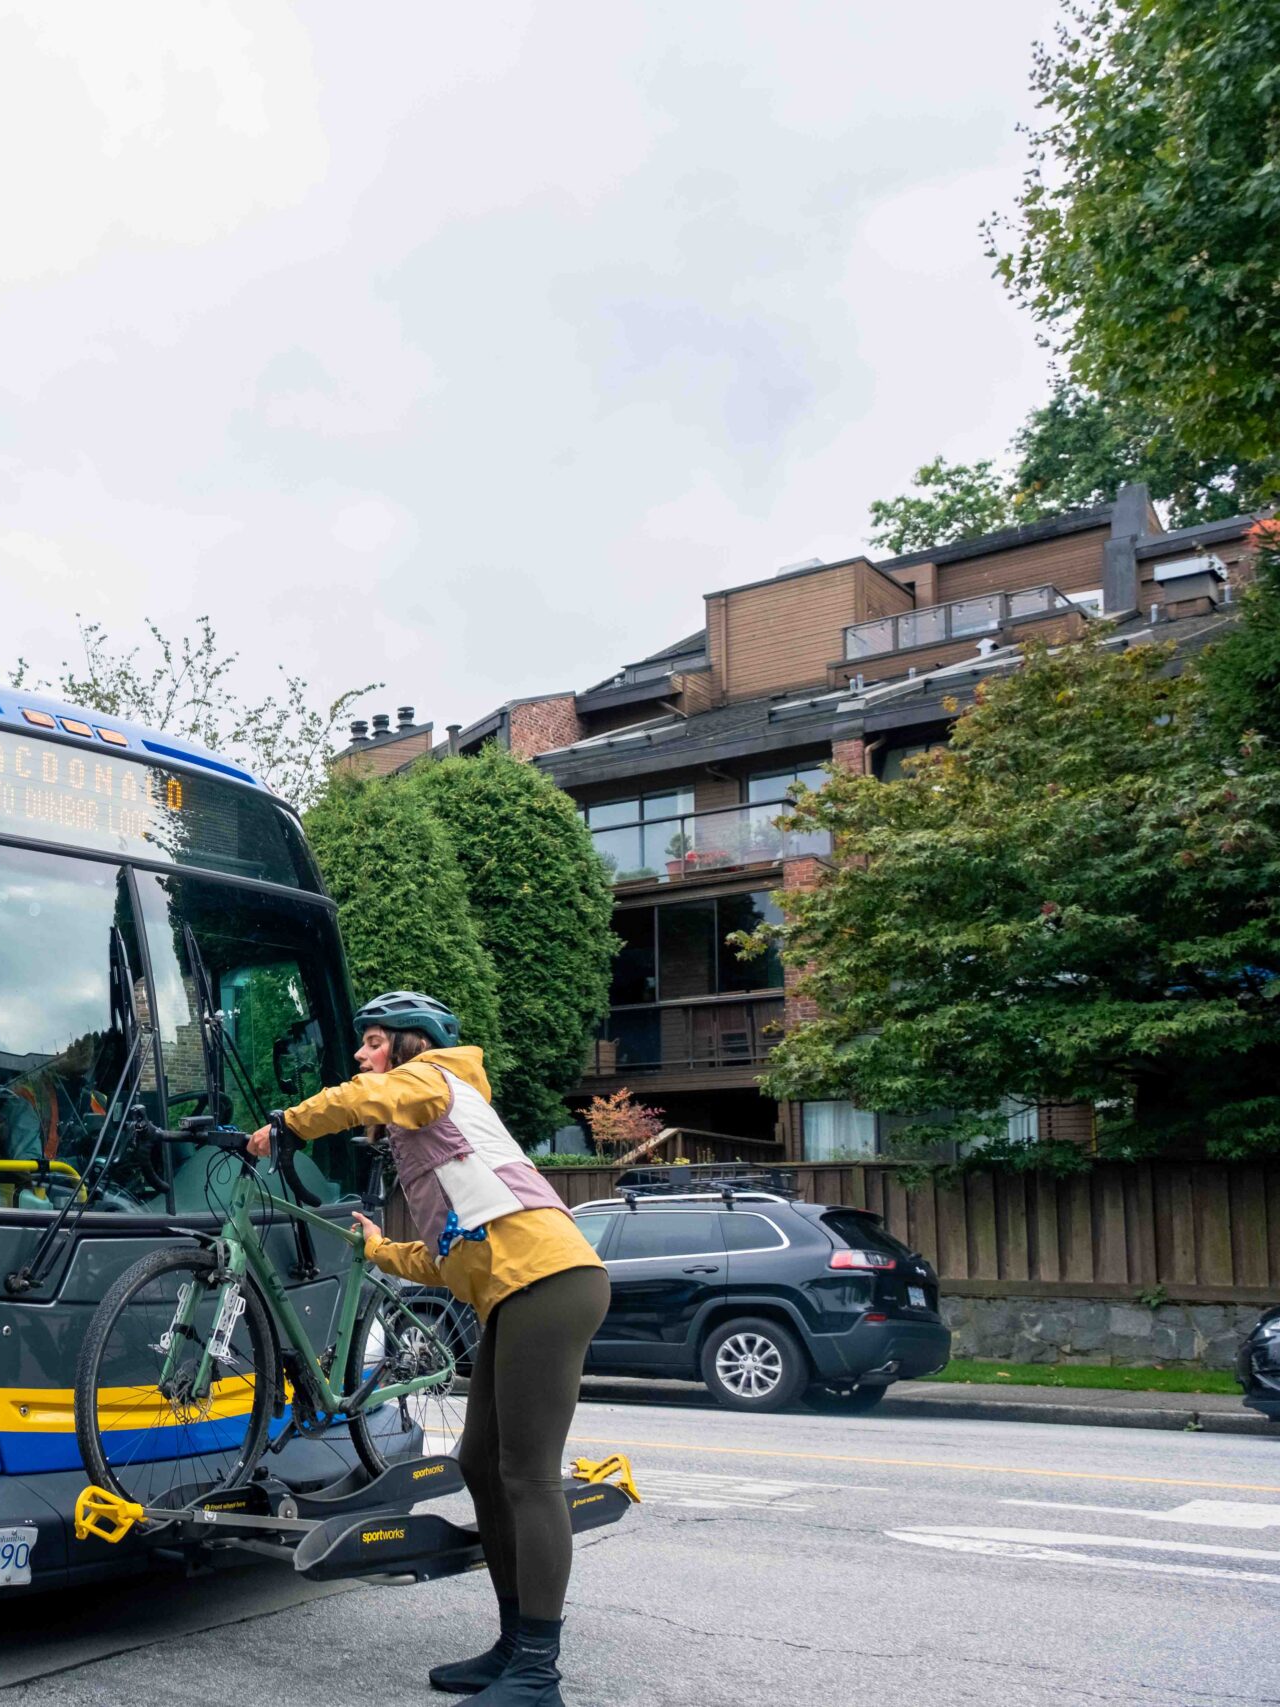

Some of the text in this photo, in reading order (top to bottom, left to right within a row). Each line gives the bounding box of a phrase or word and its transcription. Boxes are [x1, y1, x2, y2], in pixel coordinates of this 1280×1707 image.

[25, 784, 99, 831] DUNBAR
[412, 1464, 445, 1480] sportworks
[362, 1528, 405, 1544] sportworks
